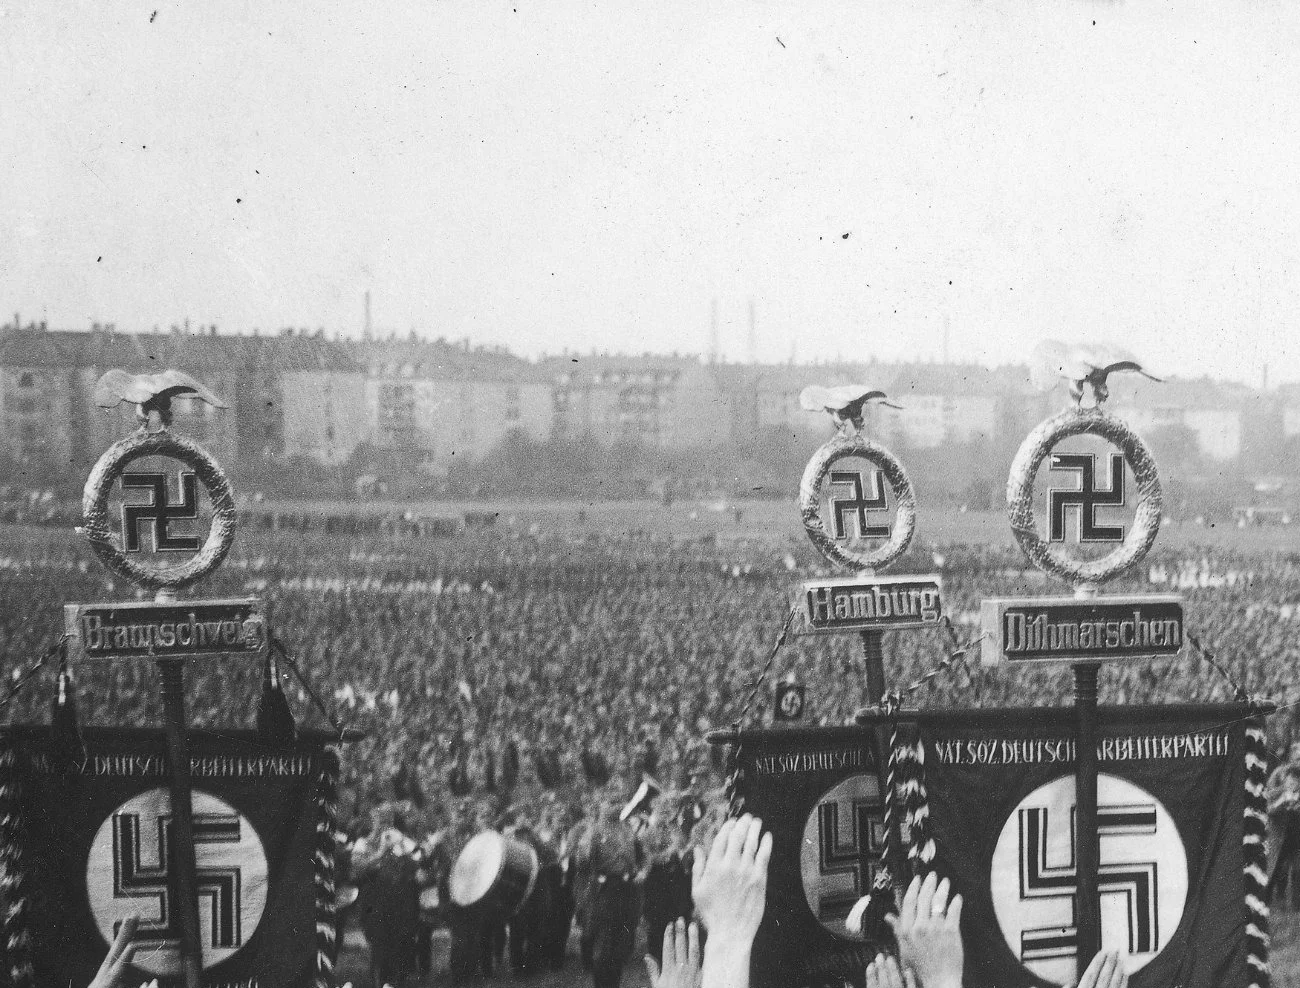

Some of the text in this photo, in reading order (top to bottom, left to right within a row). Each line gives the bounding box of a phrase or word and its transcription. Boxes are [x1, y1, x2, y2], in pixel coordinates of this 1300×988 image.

[808, 586, 940, 623] Hamburg
[83, 612, 267, 651] Braunschweig
[1005, 611, 1181, 652] Dithmarschen
[94, 754, 164, 776] DEUTSCH
[190, 756, 311, 777] RBEITERPARTEI
[1002, 739, 1076, 763] DEUTSCH
[1097, 733, 1228, 760] RBEITERPARTEI
